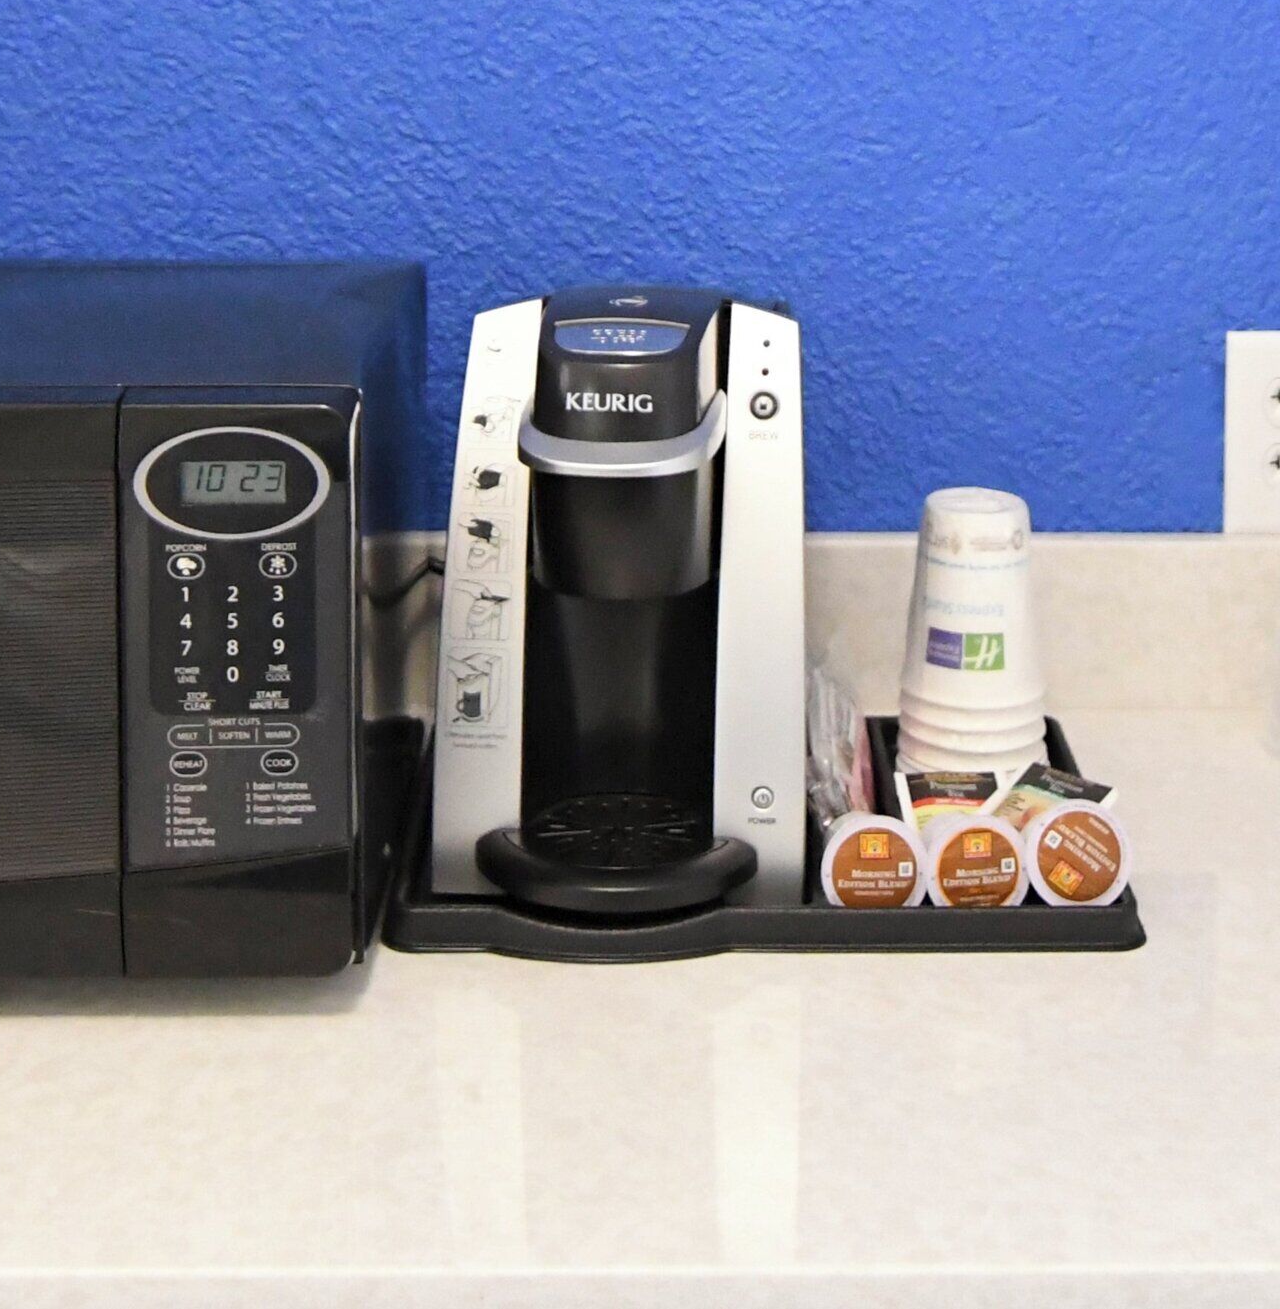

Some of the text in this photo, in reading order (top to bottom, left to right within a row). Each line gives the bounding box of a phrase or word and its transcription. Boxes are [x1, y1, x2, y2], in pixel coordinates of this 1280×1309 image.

[565, 392, 654, 413] KEURIG
[748, 430, 778, 441] BREW
[165, 544, 207, 552] POPCORN
[261, 543, 297, 551] DEFROST
[181, 586, 189, 602] 1
[227, 586, 239, 602] 2
[272, 585, 284, 601] 3
[180, 613, 192, 629] 4
[227, 613, 239, 629] 5
[272, 612, 284, 628] 6
[180, 639, 192, 657] 7
[227, 639, 239, 657] 8
[272, 638, 284, 656] 9
[174, 667, 200, 675] POWER
[227, 666, 239, 683] 0
[177, 675, 197, 683] LEVEL
[265, 673, 291, 682] CLOCK
[186, 692, 208, 700] STOP
[256, 691, 282, 699] START
[183, 702, 211, 711] CLEAR
[249, 700, 290, 710] MINUTE PLUS
[208, 717, 260, 726] SHORT CUTS
[176, 732, 198, 740] MELT
[218, 731, 250, 740] SOFTEN
[264, 731, 291, 739] WARM
[173, 760, 203, 769] REHEAT
[265, 759, 292, 767] COOK
[747, 817, 777, 825] POWER
